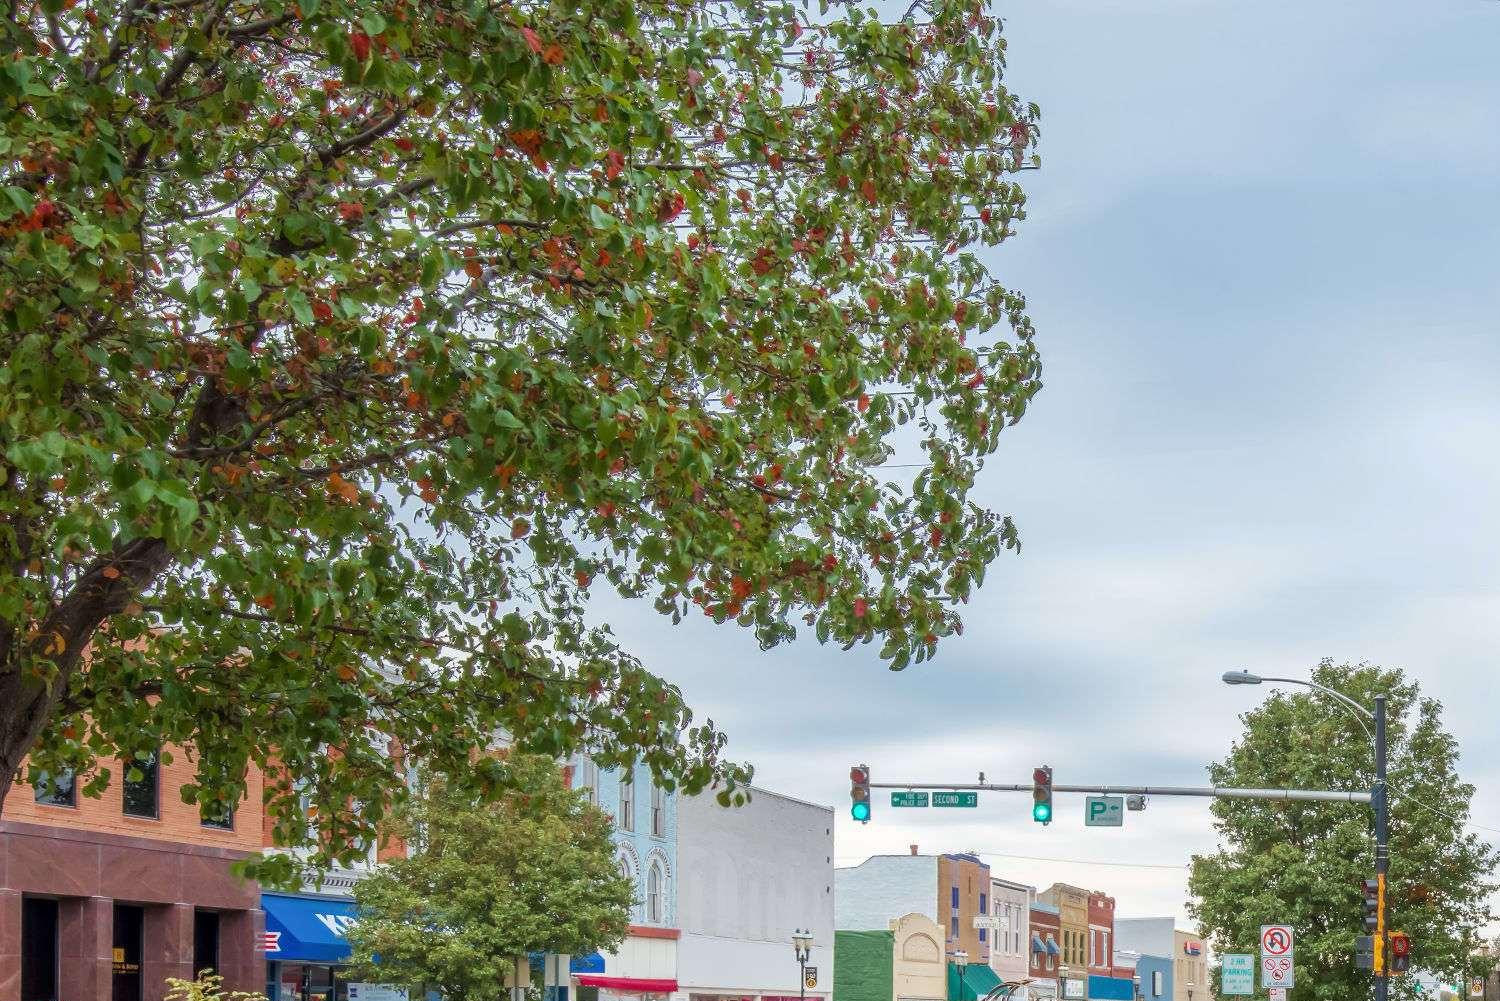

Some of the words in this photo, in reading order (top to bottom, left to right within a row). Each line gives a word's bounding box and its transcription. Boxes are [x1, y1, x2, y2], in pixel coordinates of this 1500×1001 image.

[934, 795, 959, 804] SECOND
[967, 795, 975, 804] ST
[1090, 801, 1107, 821] P
